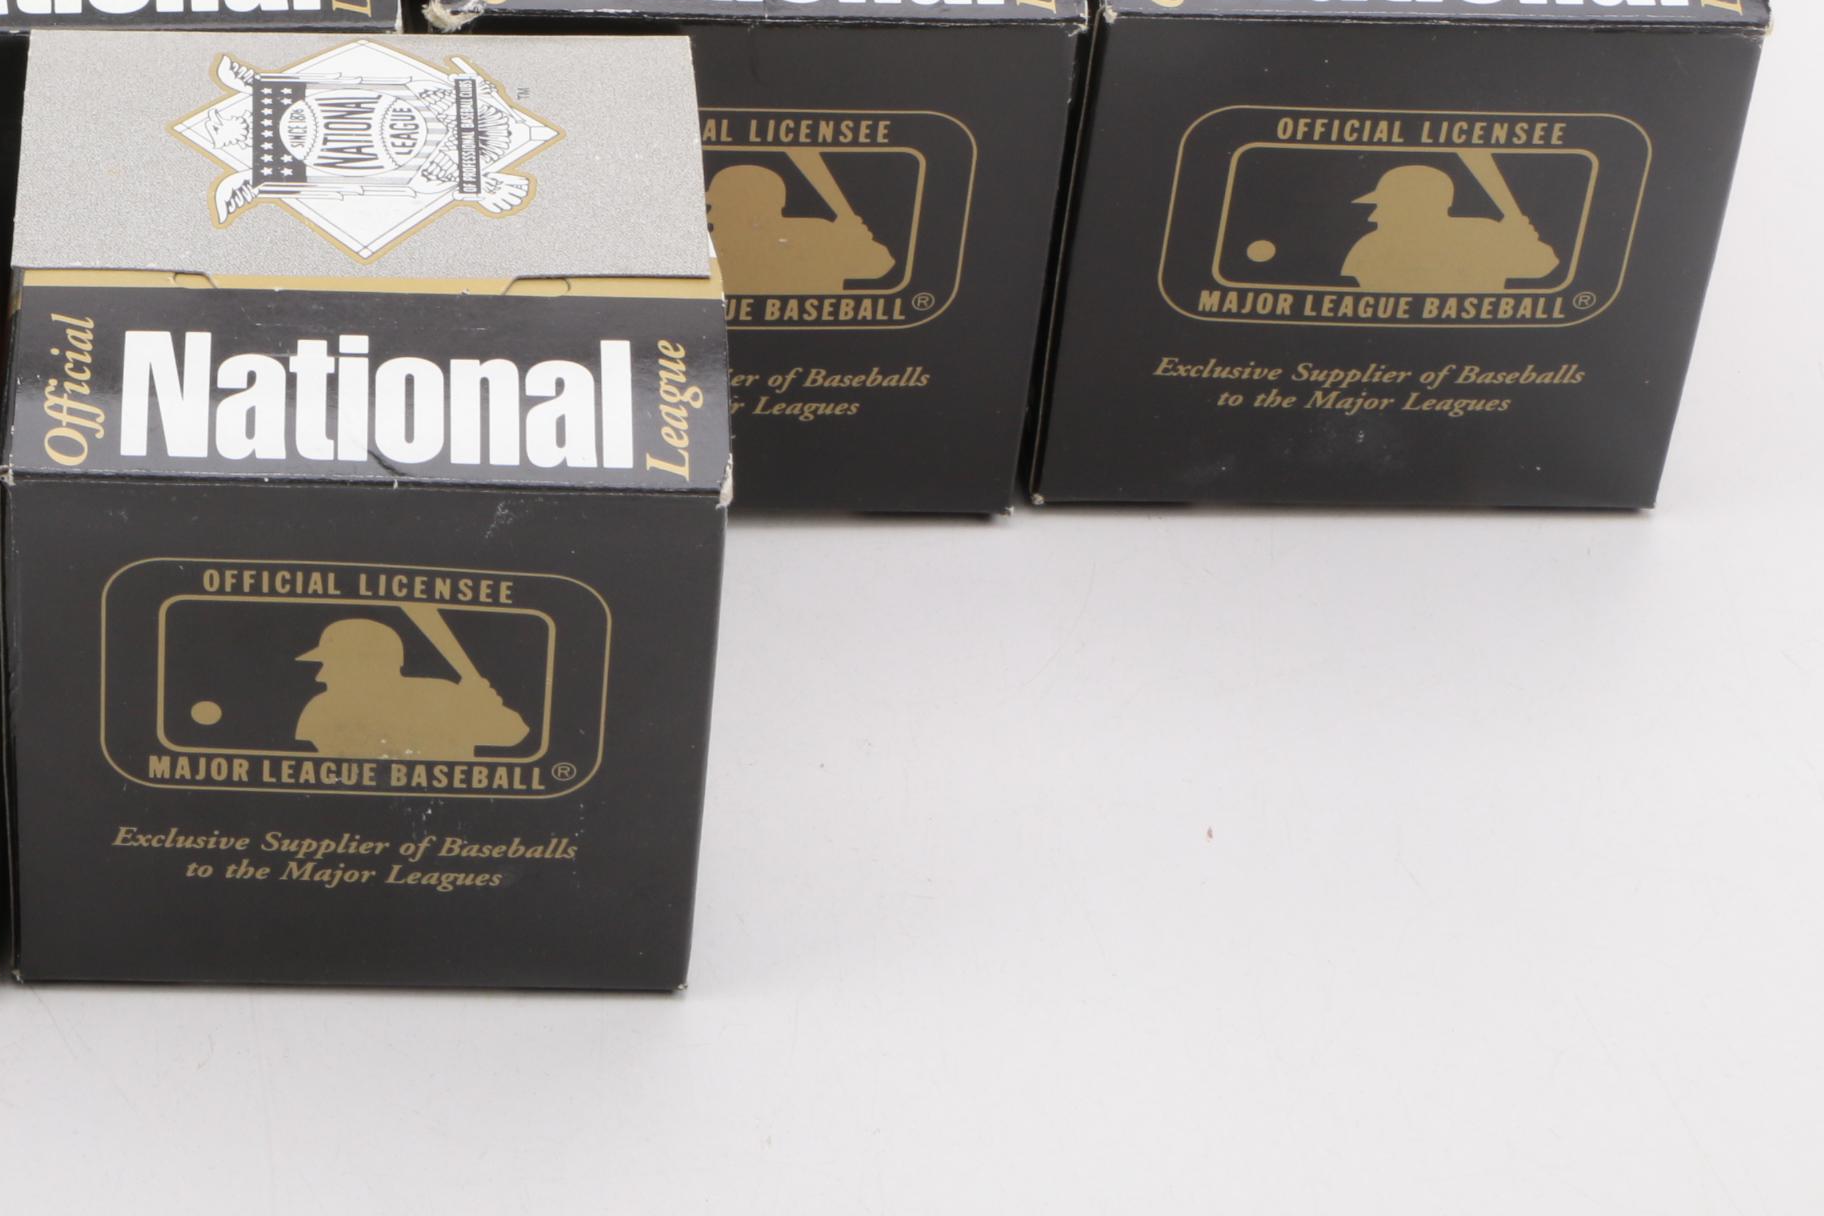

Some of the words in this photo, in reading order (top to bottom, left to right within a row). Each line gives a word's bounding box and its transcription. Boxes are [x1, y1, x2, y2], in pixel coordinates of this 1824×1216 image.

[459, 81, 472, 97] CLUBS
[460, 99, 474, 128] BASEBALL
[288, 125, 306, 148] SINCE
[313, 94, 384, 169] NATIONAL
[390, 107, 419, 155] LEAGUE
[749, 119, 891, 143] LICENSEE
[1277, 118, 1404, 143] OFFICIAL
[1421, 120, 1566, 144] LICENSEE
[462, 132, 476, 181] PROFESSIONAL
[464, 184, 476, 192] OF
[764, 298, 906, 322] BASEBALL
[1198, 290, 1293, 315] MAJOR
[1304, 294, 1410, 318] LEAGUE
[1422, 296, 1565, 319] BASEBALL
[768, 366, 803, 393] of
[805, 366, 931, 387] Baseballs
[1154, 357, 1282, 382] Exclusive
[1297, 362, 1412, 386] Supplier
[1419, 364, 1453, 388] of
[1458, 364, 1585, 385] Baseballs
[43, 315, 106, 467] Official
[120, 331, 634, 469] National
[645, 339, 704, 481] League
[753, 395, 860, 422] Leagues
[1217, 389, 1243, 407] to
[1254, 389, 1295, 409] the
[1305, 390, 1395, 415] Major
[1402, 393, 1511, 416] Leagues
[203, 569, 341, 595] OFFICIAL
[359, 573, 513, 603] LICENSEE
[149, 756, 249, 782] MAJOR
[262, 761, 377, 785] LEAGUE
[391, 764, 545, 790] BASEBALL
[112, 827, 251, 851] Exclusive
[261, 832, 390, 858] Supplier
[400, 835, 435, 862] of
[438, 838, 577, 859] Baseballs
[186, 861, 214, 880] to
[225, 860, 269, 882] the
[280, 861, 376, 888] Major
[387, 864, 502, 892] Leagues
